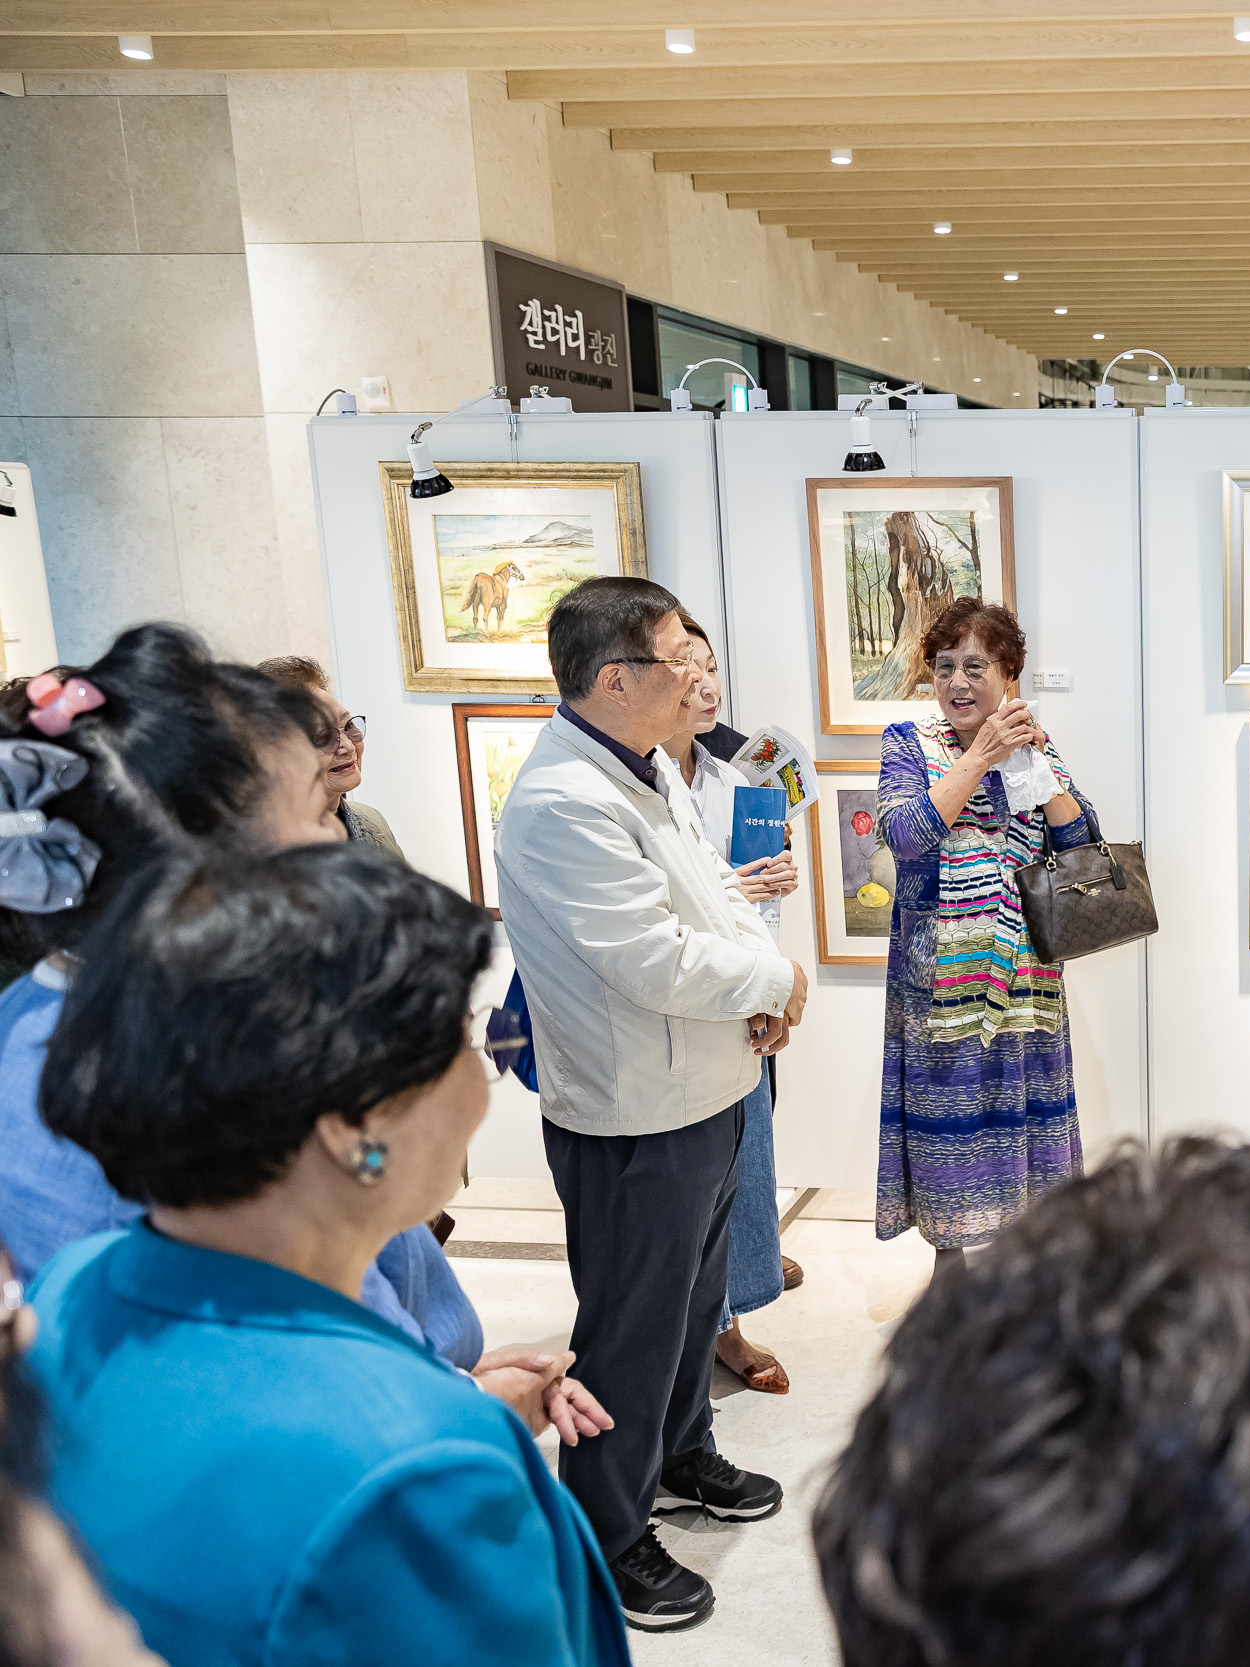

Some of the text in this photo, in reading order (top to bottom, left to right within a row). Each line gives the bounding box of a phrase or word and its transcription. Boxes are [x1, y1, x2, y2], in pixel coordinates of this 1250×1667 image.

[519, 298, 618, 367] 갤러리 광진
[526, 362, 613, 391] GALLERY GWANGJIN
[744, 817, 765, 827] 시간의
